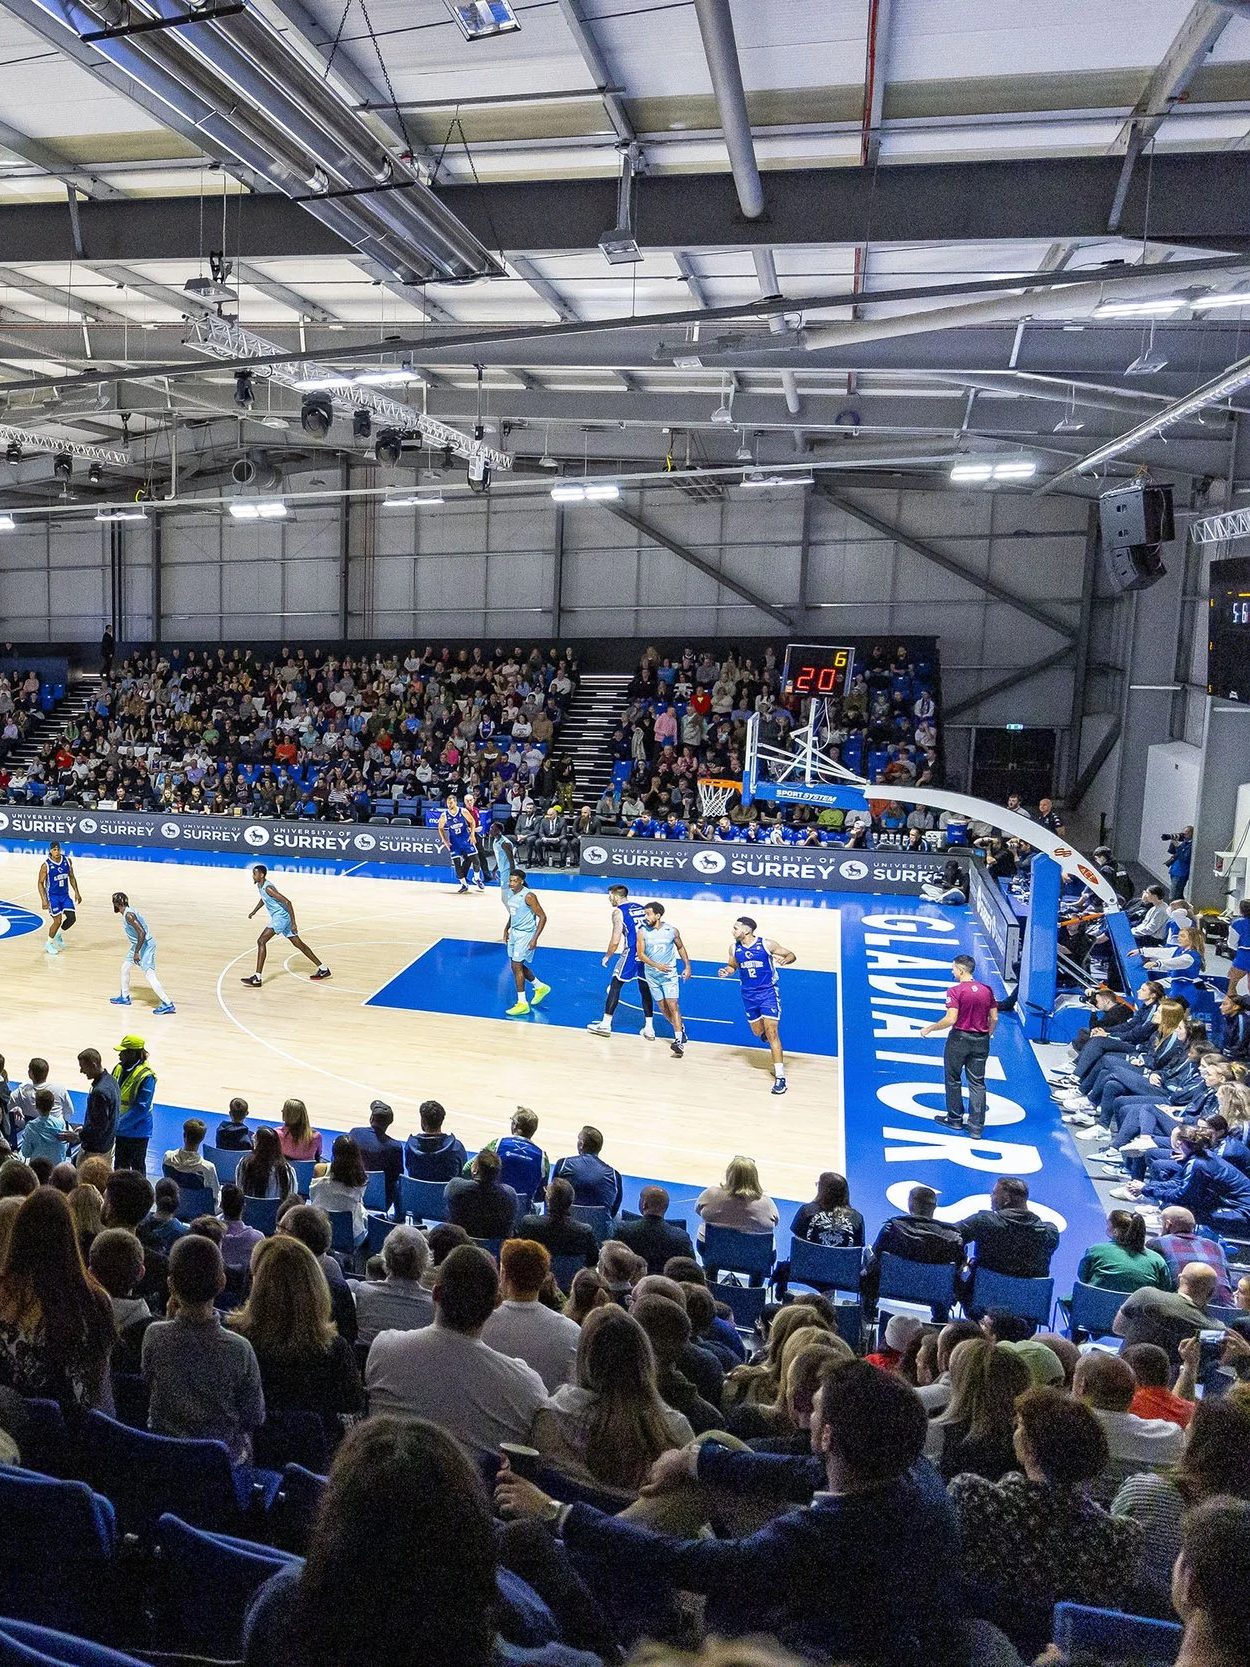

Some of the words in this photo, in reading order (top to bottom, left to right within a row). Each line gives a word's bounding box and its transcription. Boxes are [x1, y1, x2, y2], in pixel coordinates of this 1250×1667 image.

[835, 652, 847, 667] 6
[797, 668, 836, 691] 20
[776, 789, 802, 798] SPORT
[803, 792, 837, 802] SYSTEM
[12, 820, 76, 834] SURREY
[101, 825, 154, 836] SURREY
[184, 829, 241, 842] SURREY
[273, 835, 350, 850] SURREY
[379, 842, 445, 854] SURREY
[612, 854, 688, 868] SURREY
[732, 853, 812, 862] UNIVERSITY
[732, 861, 835, 880] SURREY
[861, 914, 1068, 1233] GLADIATORS
